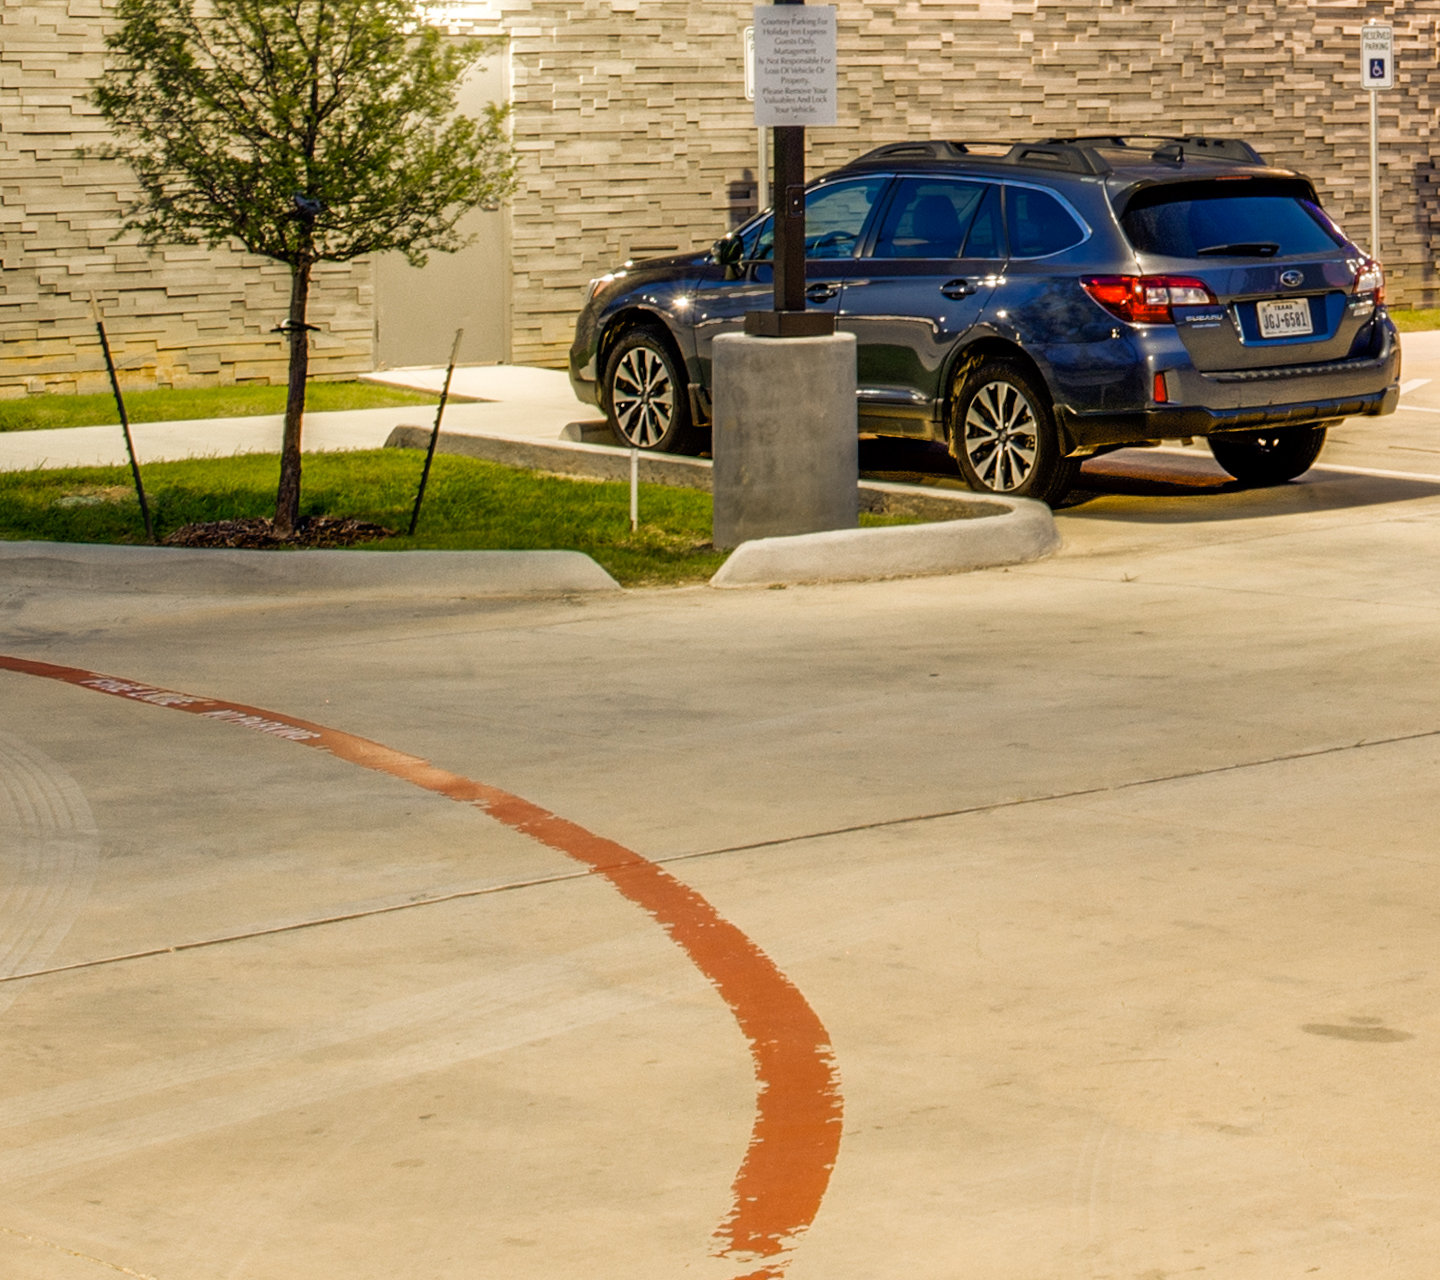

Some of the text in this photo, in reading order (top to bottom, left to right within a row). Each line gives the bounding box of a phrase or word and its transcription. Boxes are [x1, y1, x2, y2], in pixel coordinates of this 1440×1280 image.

[791, 18, 817, 27] Parking
[763, 28, 789, 37] Holiday
[802, 28, 827, 38] Express
[1363, 30, 1391, 41] RESERVED
[1364, 42, 1389, 51] PARKING
[774, 47, 817, 57] Management
[767, 57, 779, 65] Not
[781, 57, 819, 66] Responsible
[791, 66, 815, 74] Vehicle
[816, 66, 826, 74] Or
[762, 87, 828, 95] Please Remove Your
[763, 96, 796, 105] Valuables
[797, 96, 811, 104] And
[774, 106, 790, 114] Your
